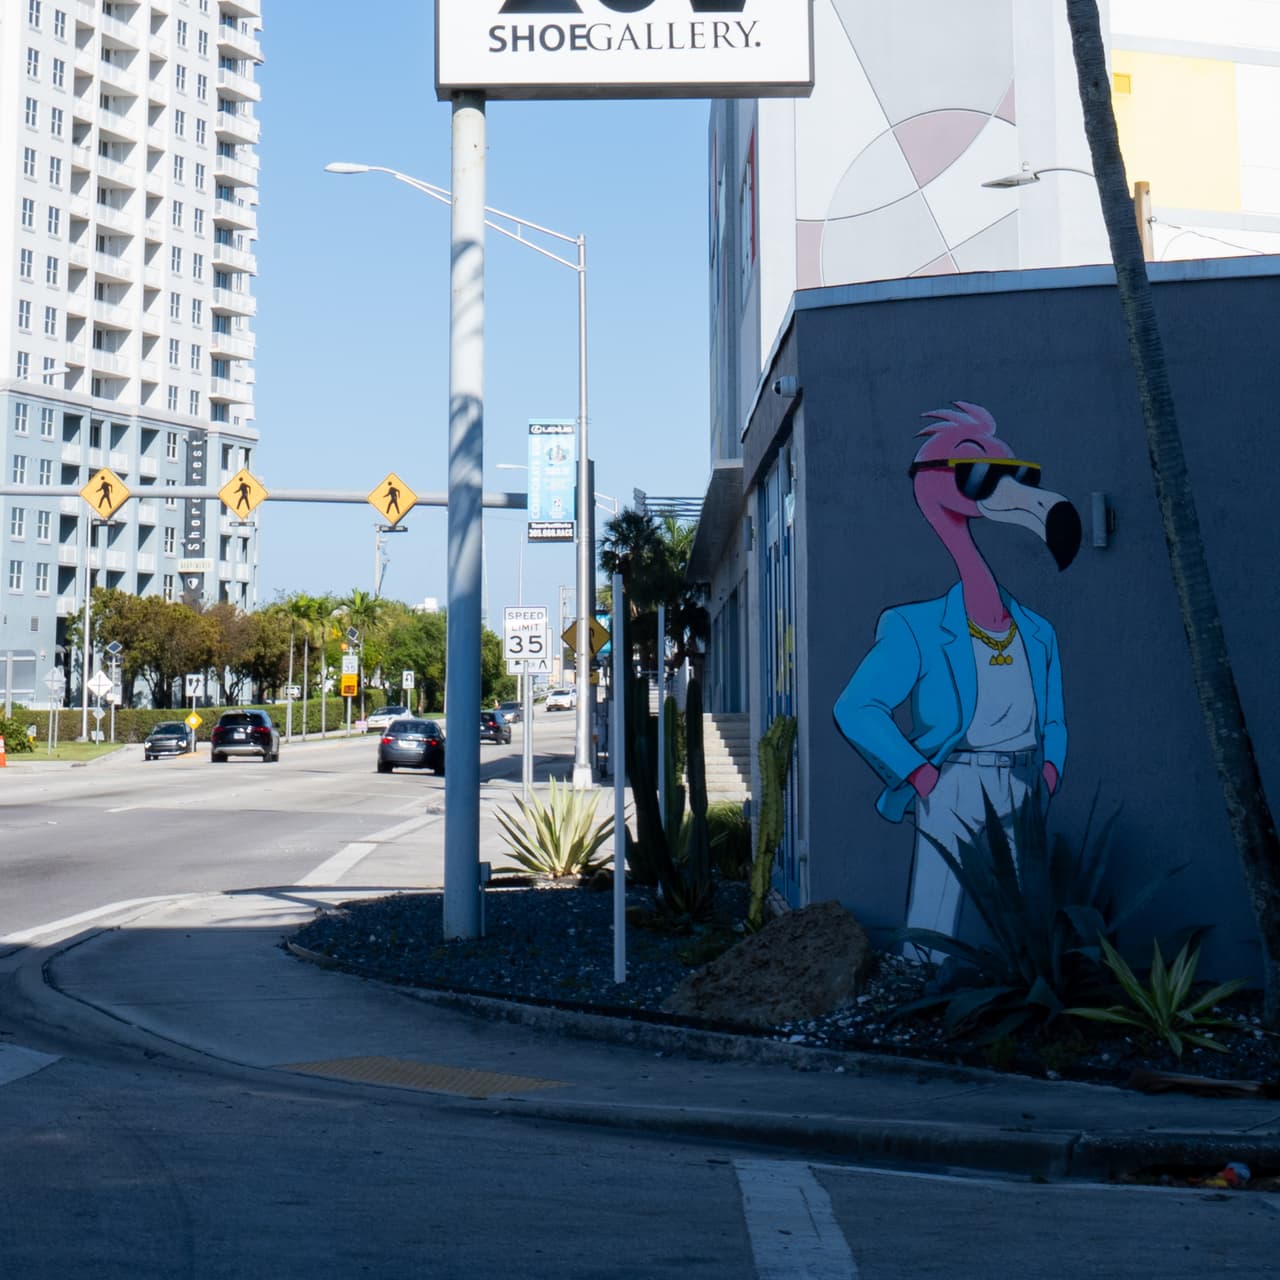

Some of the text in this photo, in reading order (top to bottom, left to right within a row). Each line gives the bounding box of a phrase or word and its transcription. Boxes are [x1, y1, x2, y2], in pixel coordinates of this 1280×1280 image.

[507, 611, 544, 620] SPEED
[511, 624, 540, 632] LIMIT
[509, 635, 543, 654] 35
